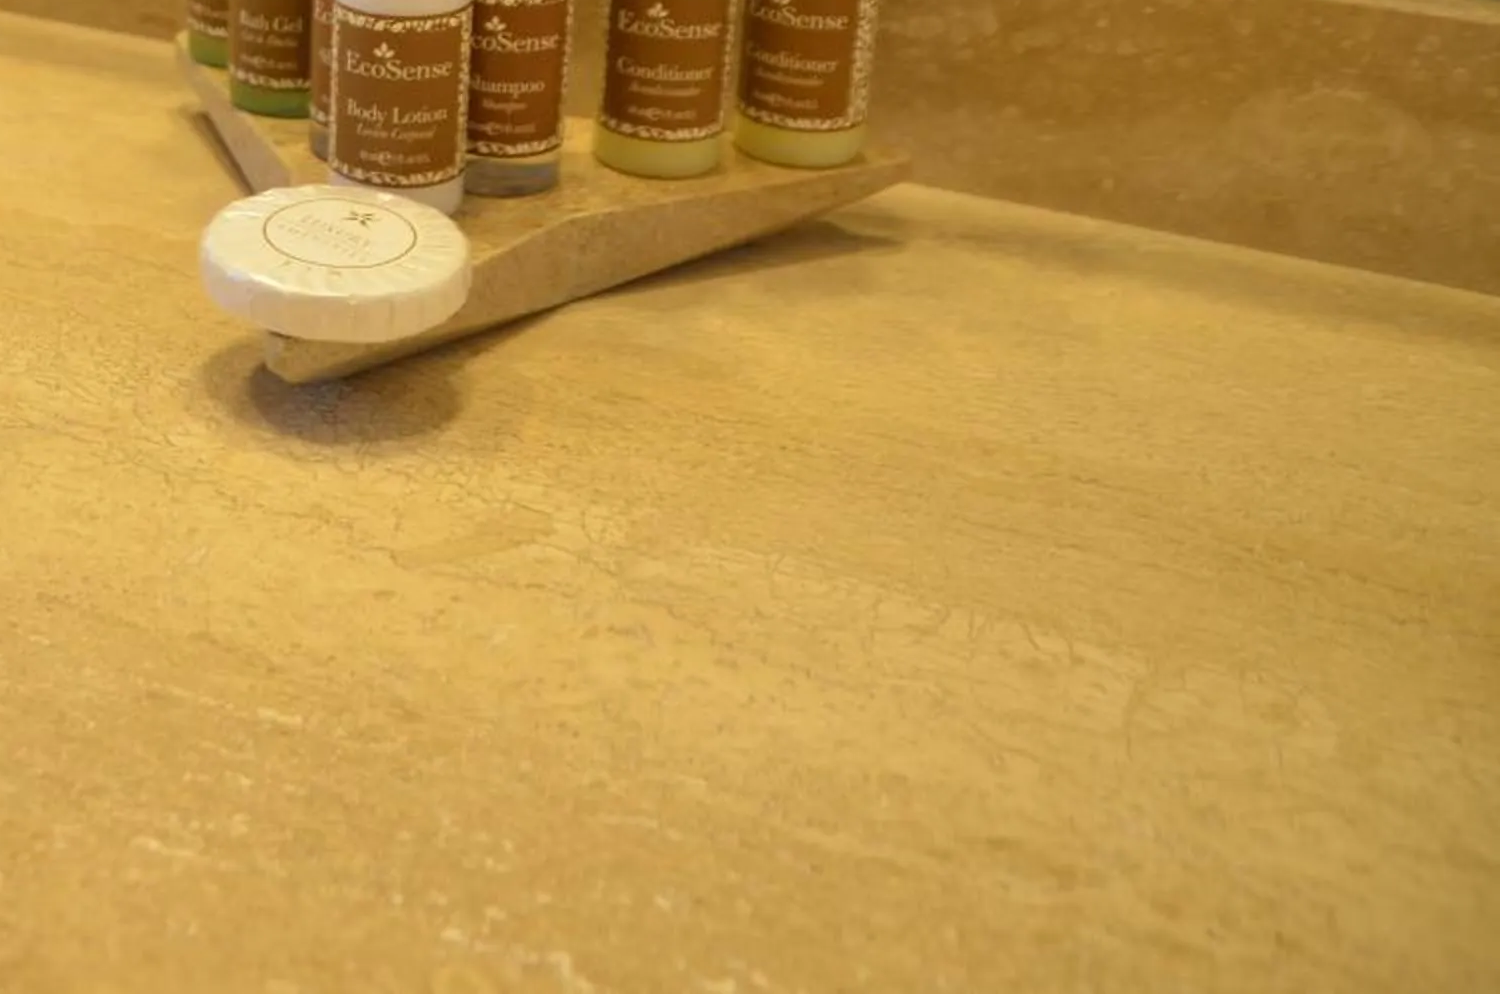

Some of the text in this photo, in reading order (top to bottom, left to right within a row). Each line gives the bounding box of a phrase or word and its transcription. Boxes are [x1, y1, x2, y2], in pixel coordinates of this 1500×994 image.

[617, 8, 723, 40] EcoSense
[471, 31, 560, 53] coSense
[346, 49, 453, 81] EcoSense
[616, 56, 715, 82] Conditioner
[347, 98, 448, 128] Body Lotion
